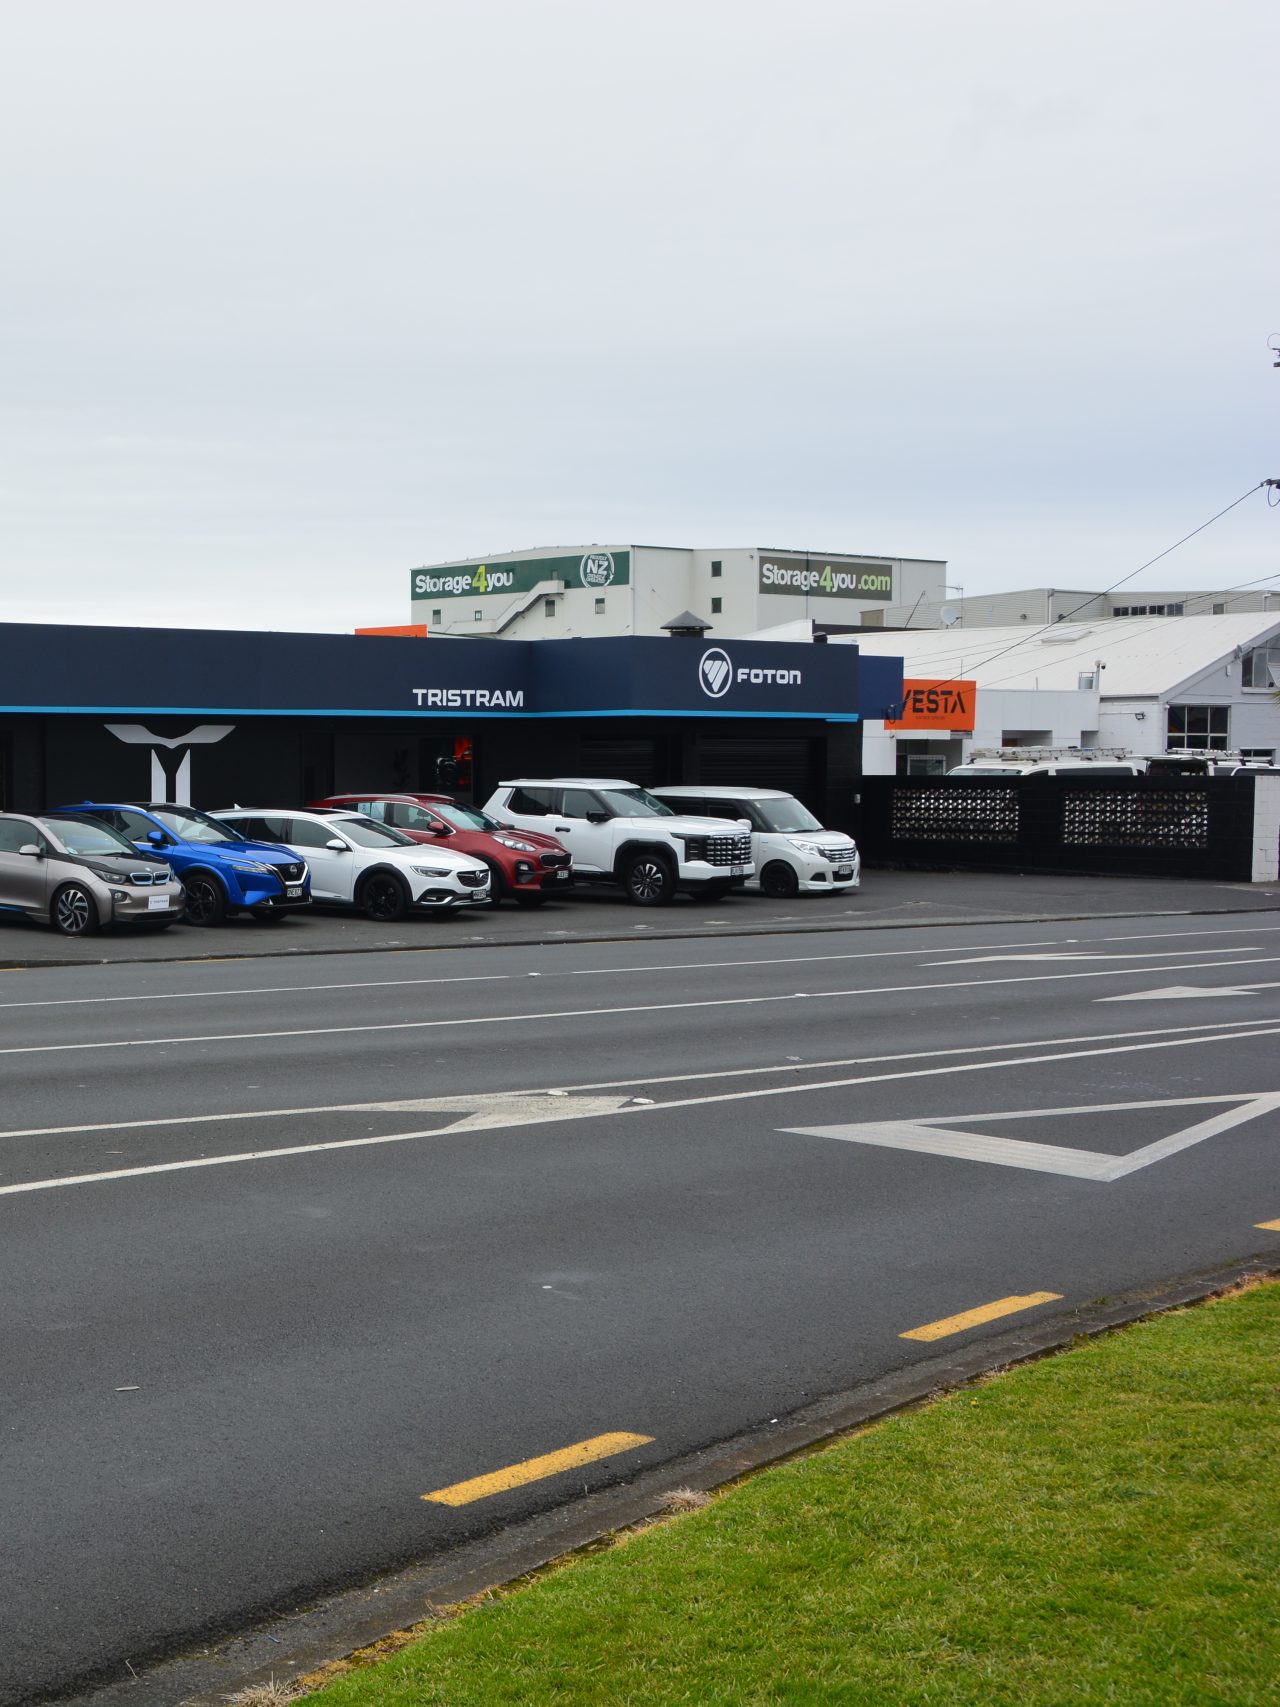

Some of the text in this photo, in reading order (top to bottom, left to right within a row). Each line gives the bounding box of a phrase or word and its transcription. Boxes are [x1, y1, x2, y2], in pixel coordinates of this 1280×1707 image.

[587, 559, 608, 575] NZ
[415, 565, 513, 594] Storage4you
[737, 668, 802, 685] FOTON
[412, 688, 524, 707] TRISTRAM
